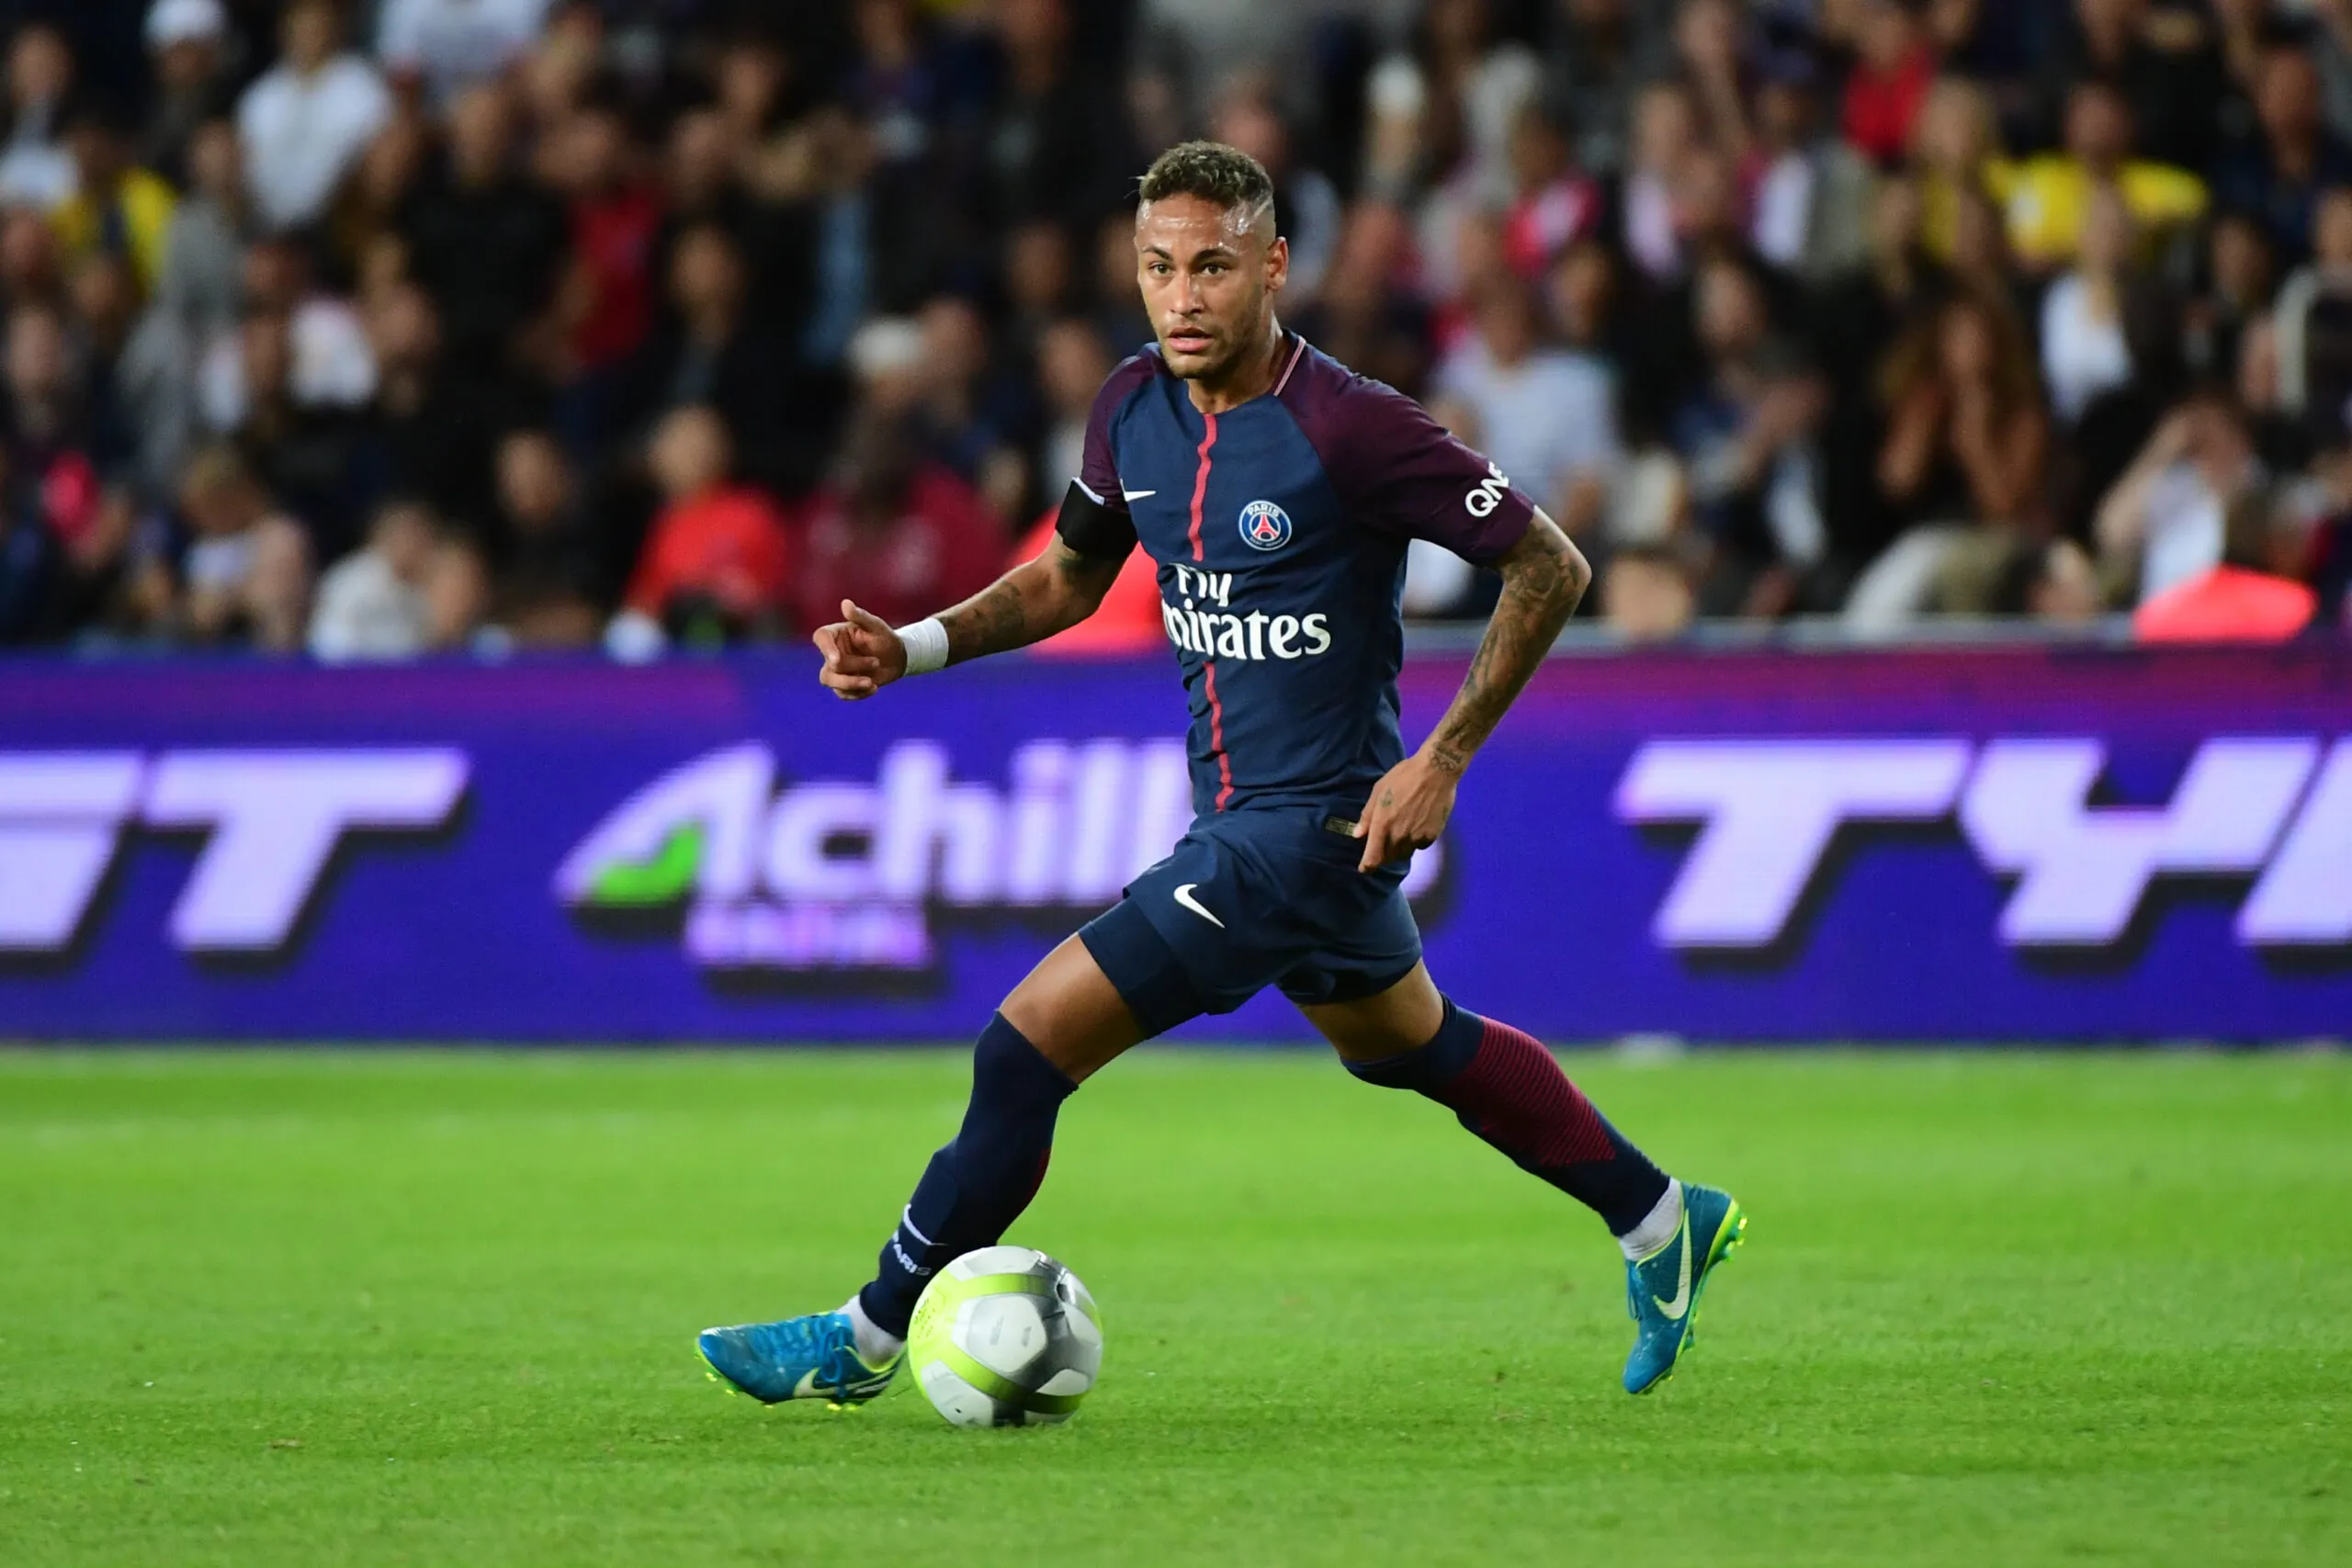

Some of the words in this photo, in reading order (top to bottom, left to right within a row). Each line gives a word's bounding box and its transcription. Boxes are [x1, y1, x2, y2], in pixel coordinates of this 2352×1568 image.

[1247, 503, 1280, 517] PARIS
[1161, 598, 1331, 660] mirates
[555, 738, 1442, 906] Achill
